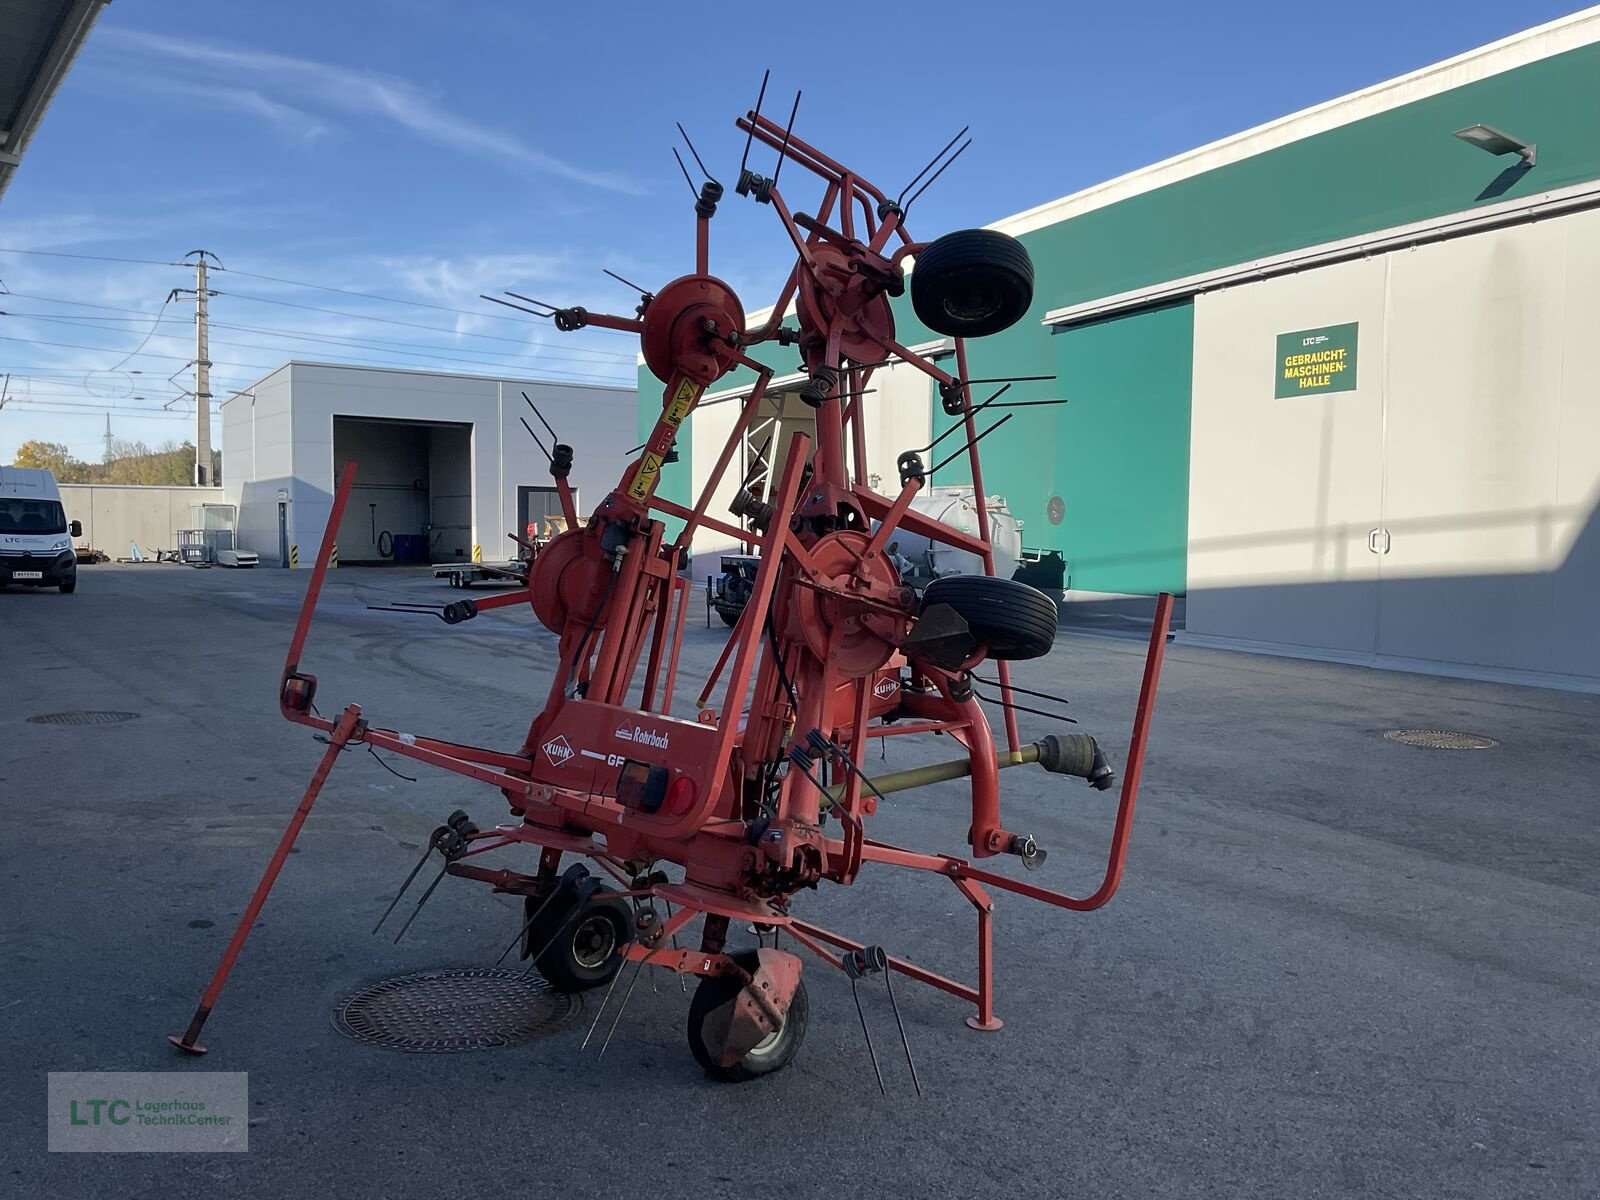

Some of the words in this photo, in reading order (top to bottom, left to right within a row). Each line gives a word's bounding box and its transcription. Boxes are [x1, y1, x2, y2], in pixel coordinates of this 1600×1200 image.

[1303, 337, 1315, 346] LTC
[1285, 349, 1347, 367] GEBRAUCHT-
[1284, 361, 1347, 379] MASCHINEN-
[1299, 375, 1331, 389] HALLE
[876, 681, 897, 694] KUHN
[633, 726, 669, 749] Rohrbach
[546, 742, 570, 759] KUHN
